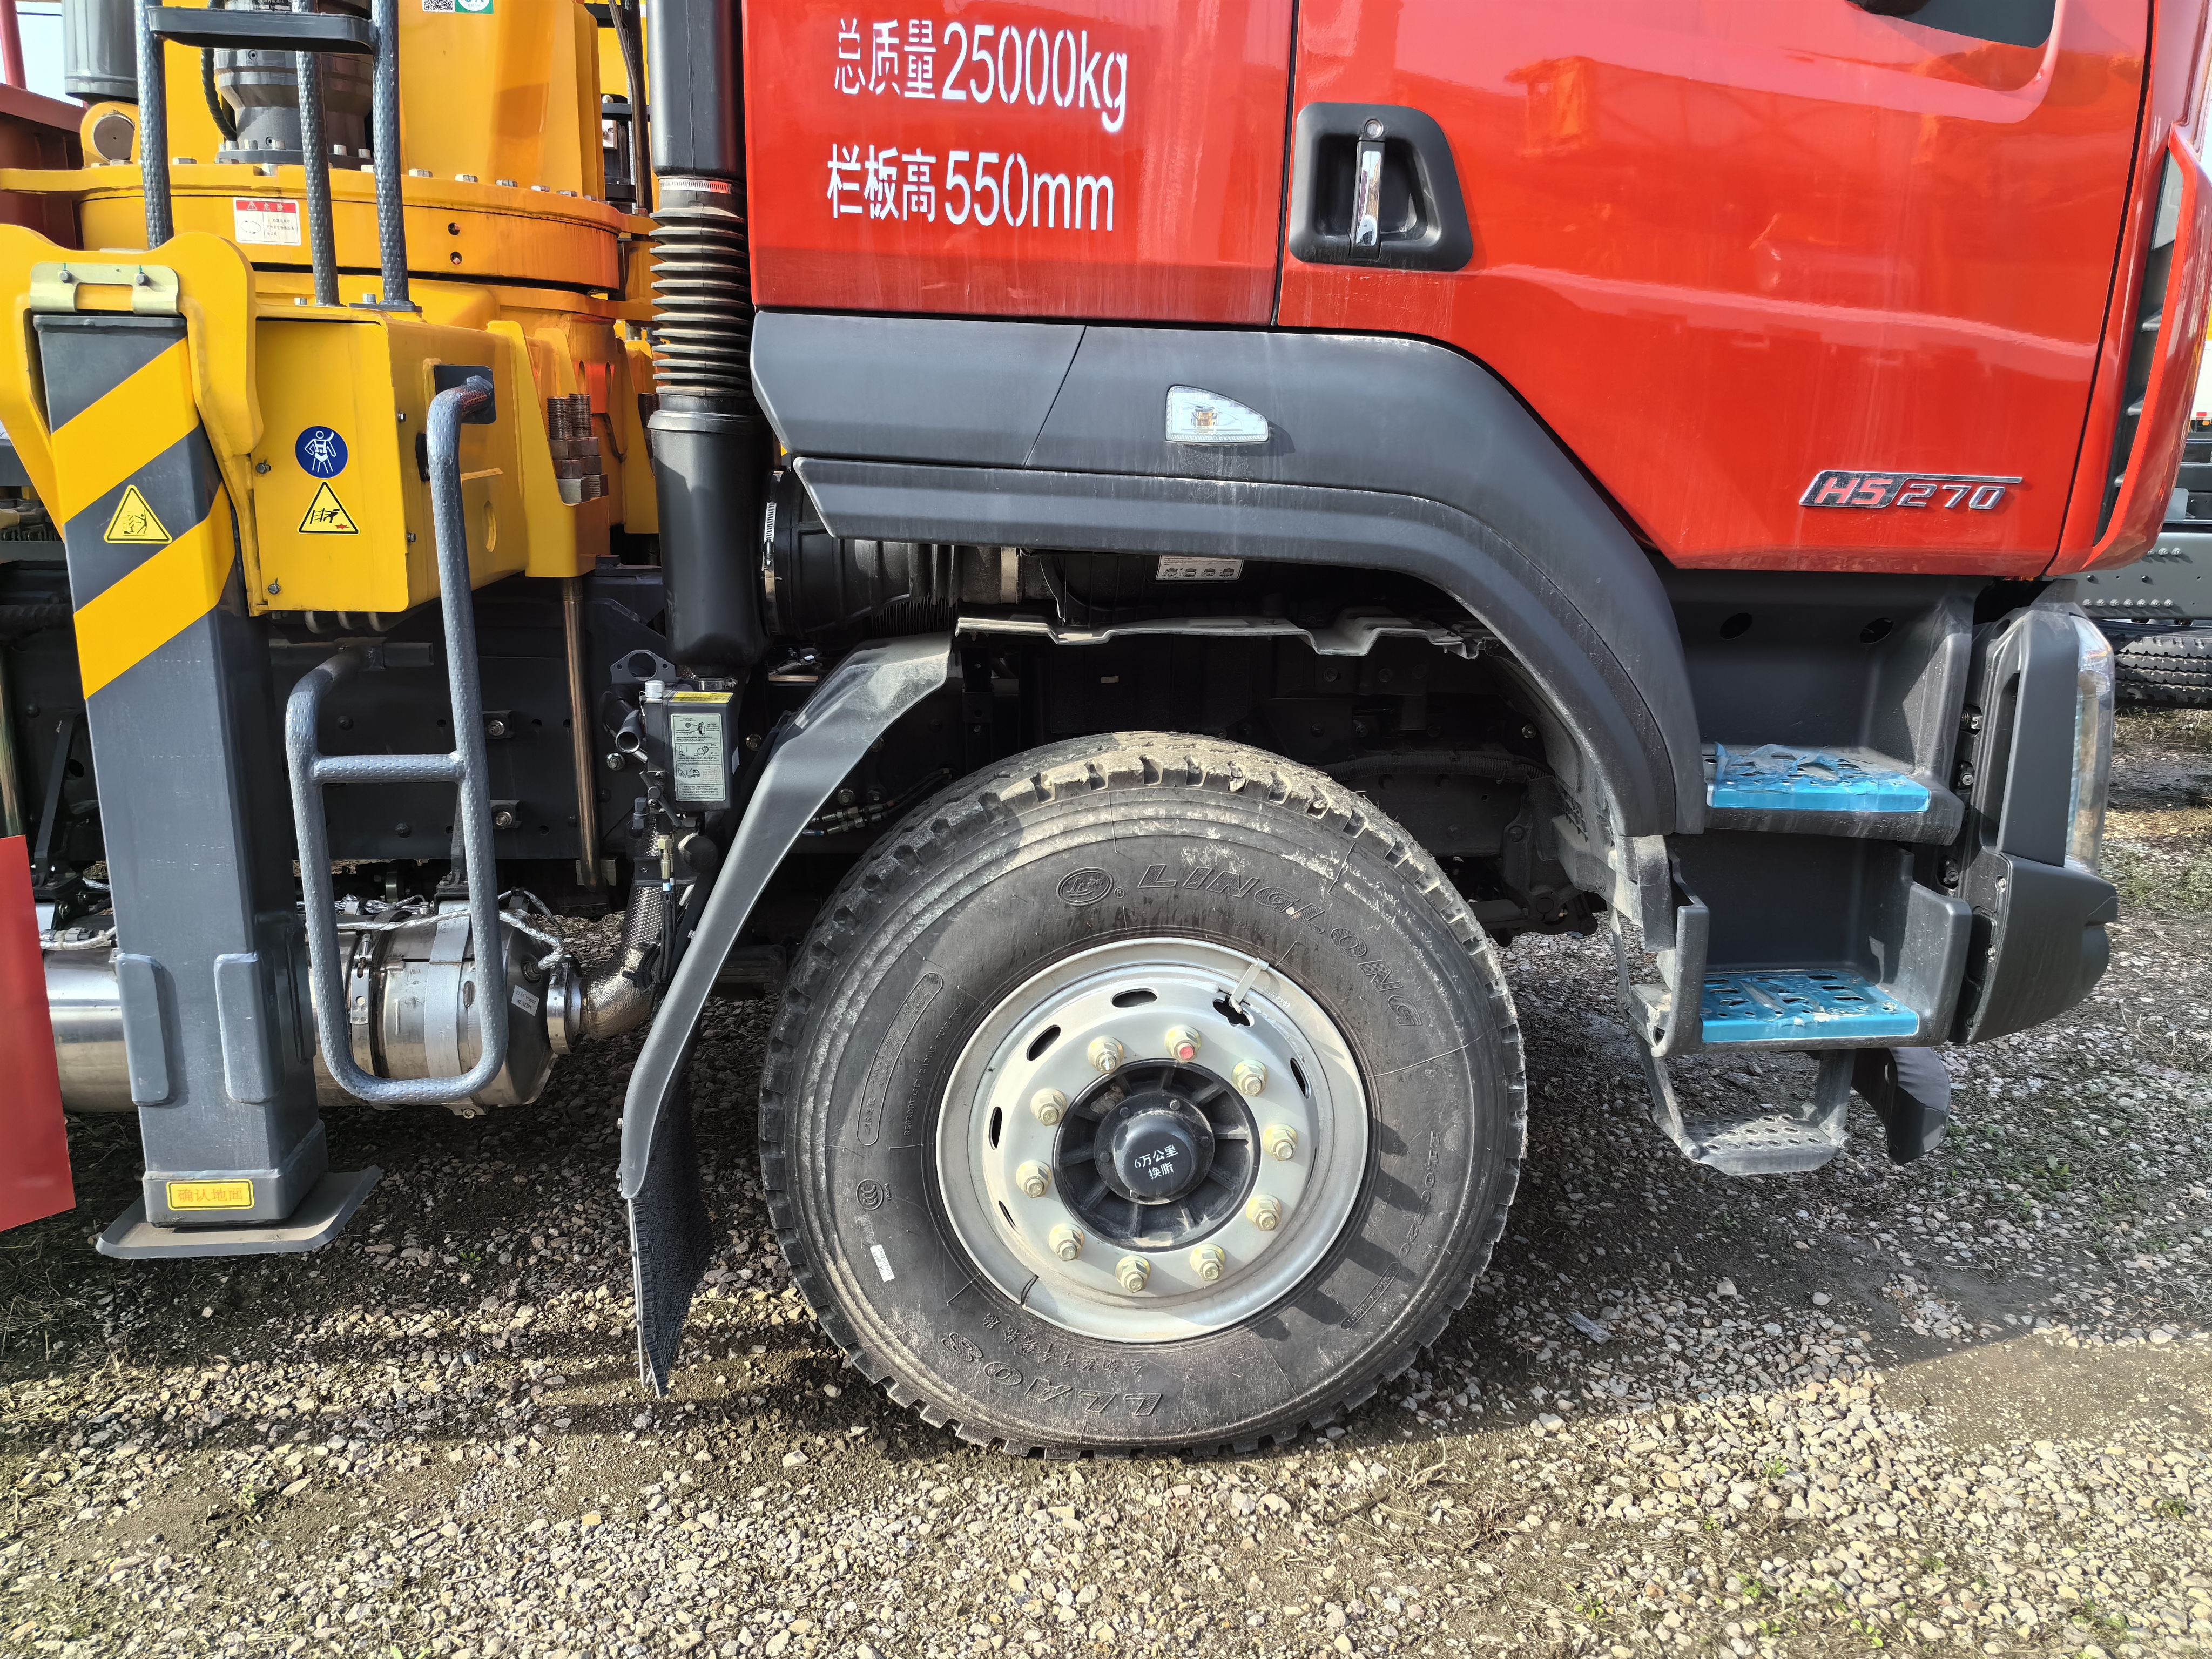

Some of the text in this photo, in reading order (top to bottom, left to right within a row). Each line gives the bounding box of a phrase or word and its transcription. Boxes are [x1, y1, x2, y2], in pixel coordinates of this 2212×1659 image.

[834, 18, 1128, 132] 总质量25000kg
[826, 144, 1114, 231] 栏板高550mm
[263, 203, 284, 211] 危险
[1897, 484, 2006, 509] 270
[1137, 862, 1424, 1028] LINGLONG
[1134, 1144, 1178, 1169] 6万公里
[1148, 1162, 1174, 1181] 换脂
[178, 1188, 243, 1202] 确认地面
[941, 1331, 1162, 1416] LLA08
